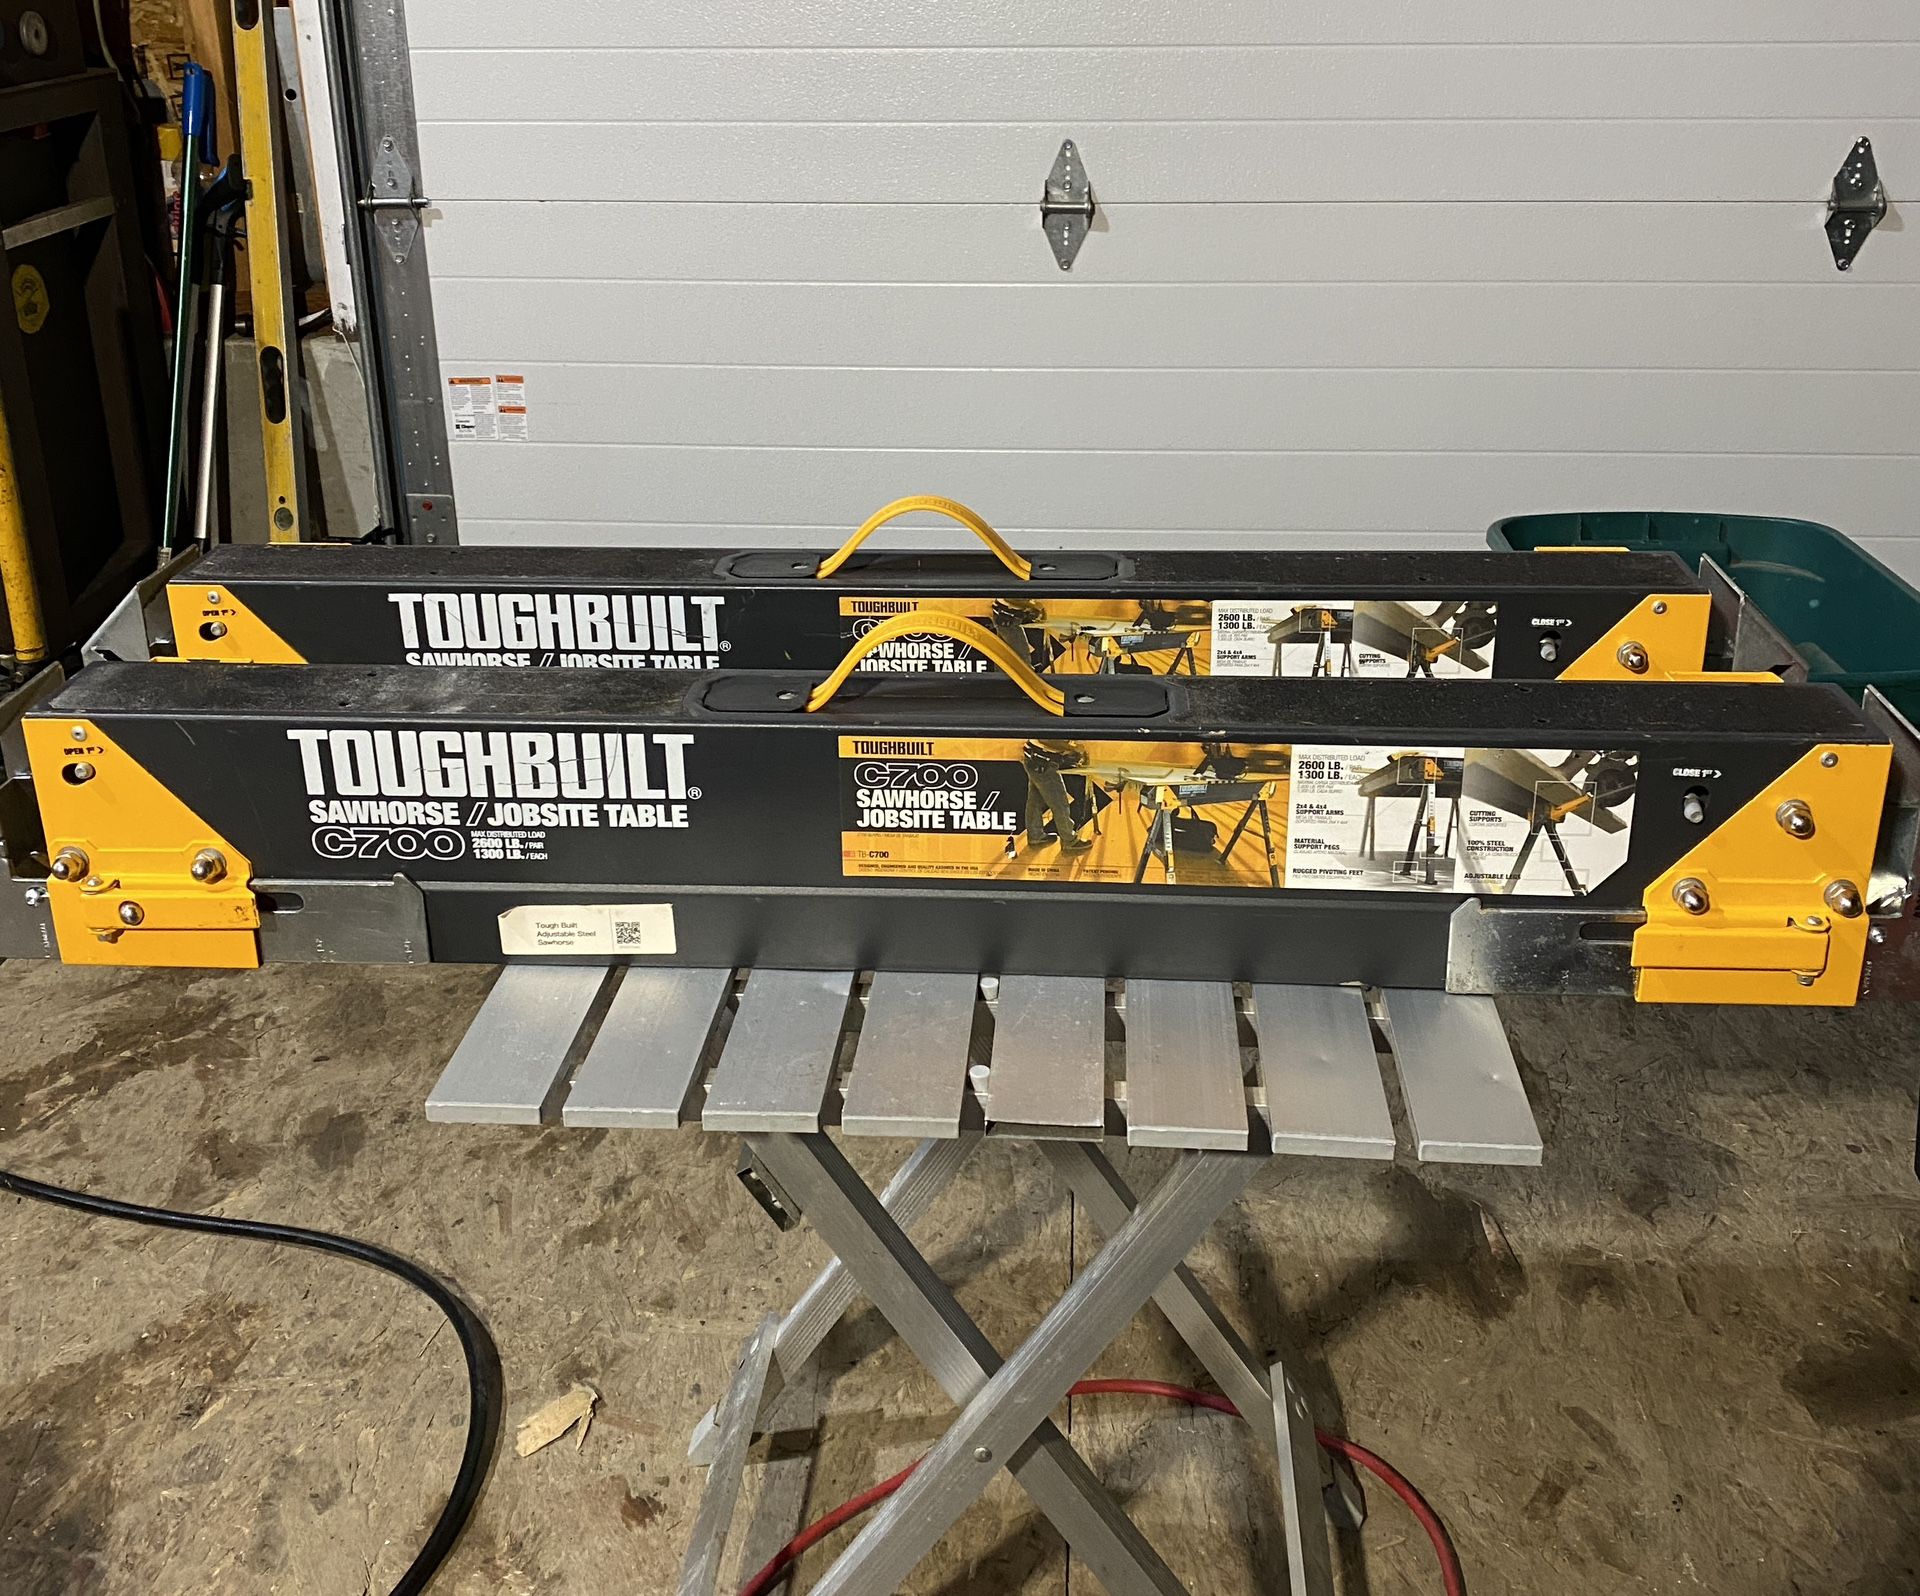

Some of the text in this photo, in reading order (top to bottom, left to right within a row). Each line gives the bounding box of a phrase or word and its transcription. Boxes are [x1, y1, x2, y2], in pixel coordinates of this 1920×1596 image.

[388, 593, 725, 651] TOUGHBUILT
[1242, 614, 1256, 622] LB.
[1218, 622, 1240, 630] 1300
[1242, 622, 1255, 630] LB.
[853, 740, 934, 756] TOUGHBUILT
[287, 729, 695, 800] TOUGHBUILT
[1298, 761, 1324, 770] 2600
[1328, 762, 1344, 770] LB.
[854, 762, 978, 790] C700
[1298, 771, 1324, 780] 1300
[1327, 771, 1343, 780] LB.
[856, 789, 977, 810] SAWHORSE
[309, 800, 461, 826] SAWHORSE
[486, 802, 600, 828] JOBSITE
[603, 804, 689, 828] TABLE
[856, 808, 1017, 831] JOBSITE TABLE
[470, 830, 486, 838] MAX
[527, 831, 546, 839] LOAD
[312, 826, 466, 860] C700
[471, 838, 503, 848] 2600
[505, 838, 524, 849] LB.
[473, 849, 504, 859] 1300
[506, 849, 525, 860] LB.
[536, 922, 559, 930] Tough
